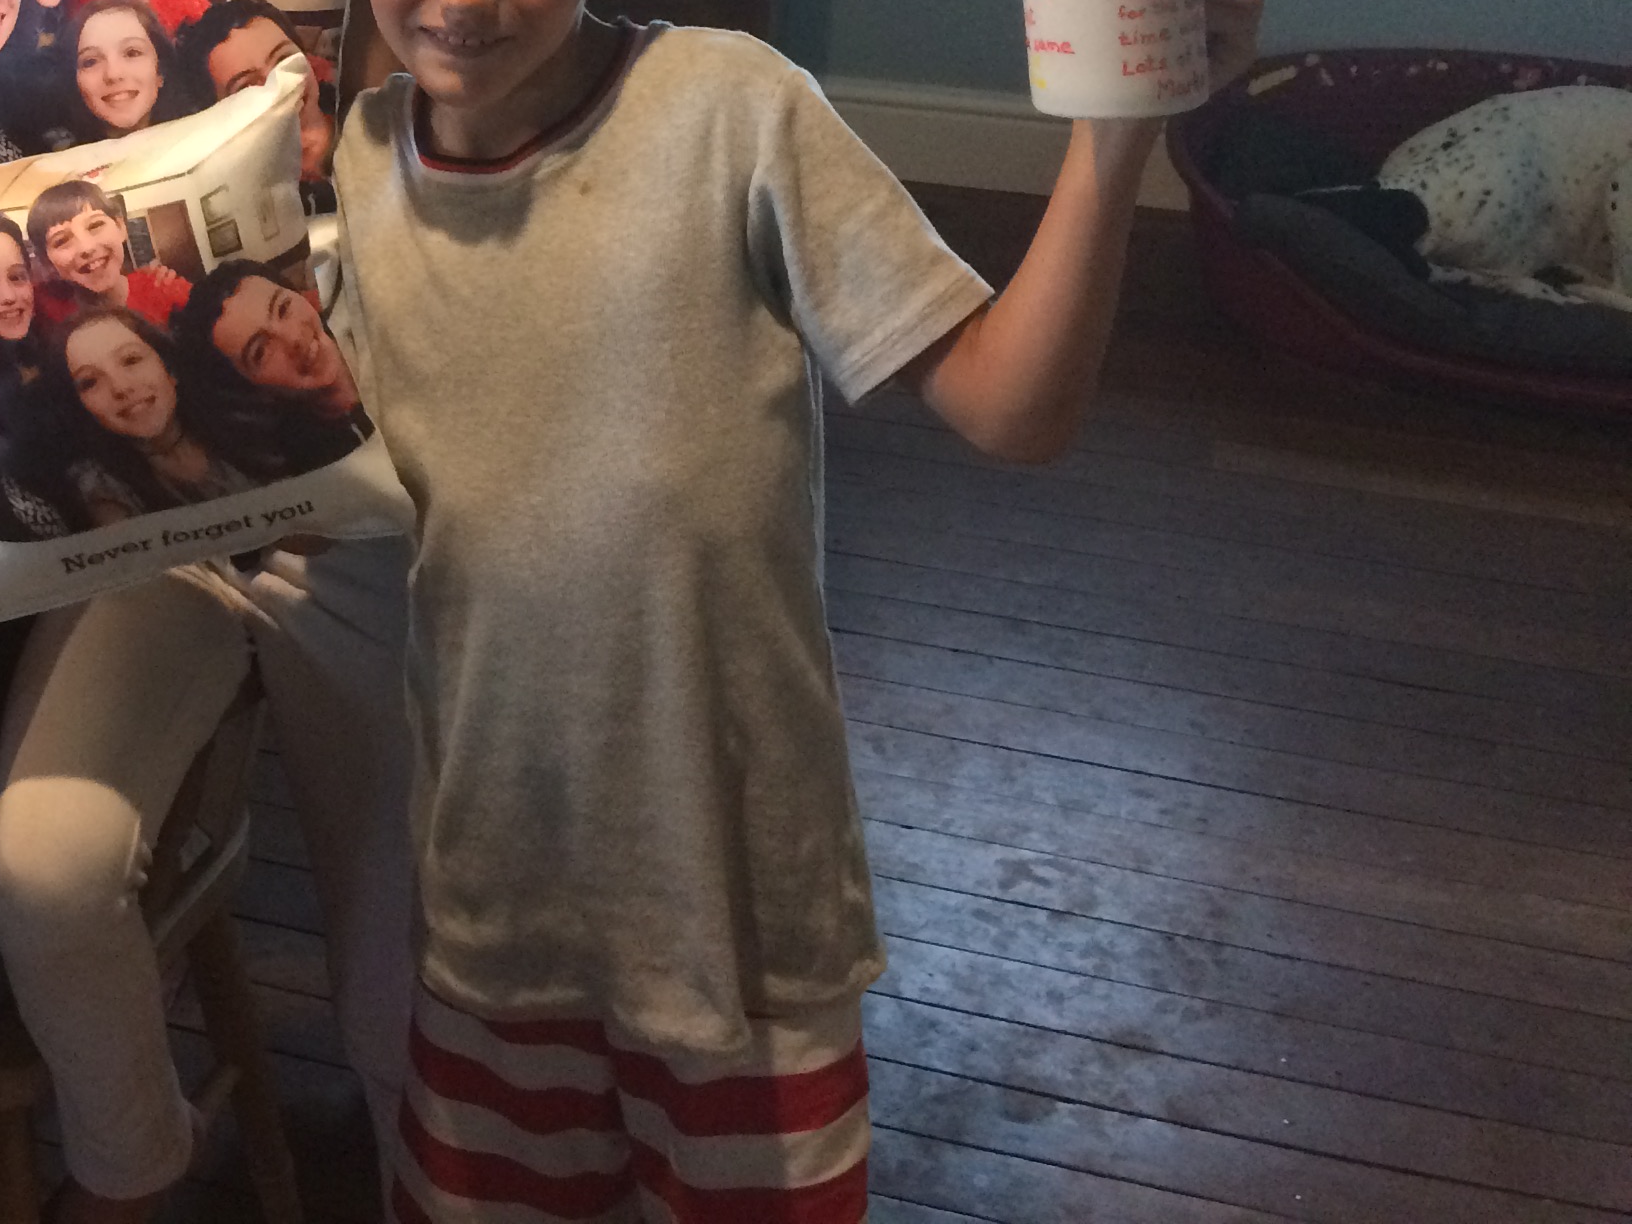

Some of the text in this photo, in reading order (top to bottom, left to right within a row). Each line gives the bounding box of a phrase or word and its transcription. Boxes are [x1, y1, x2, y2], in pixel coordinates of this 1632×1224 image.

[1118, 4, 1146, 20] for
[1118, 27, 1171, 46] time
[1122, 55, 1168, 77] Lots
[60, 499, 316, 574] Never forget you
